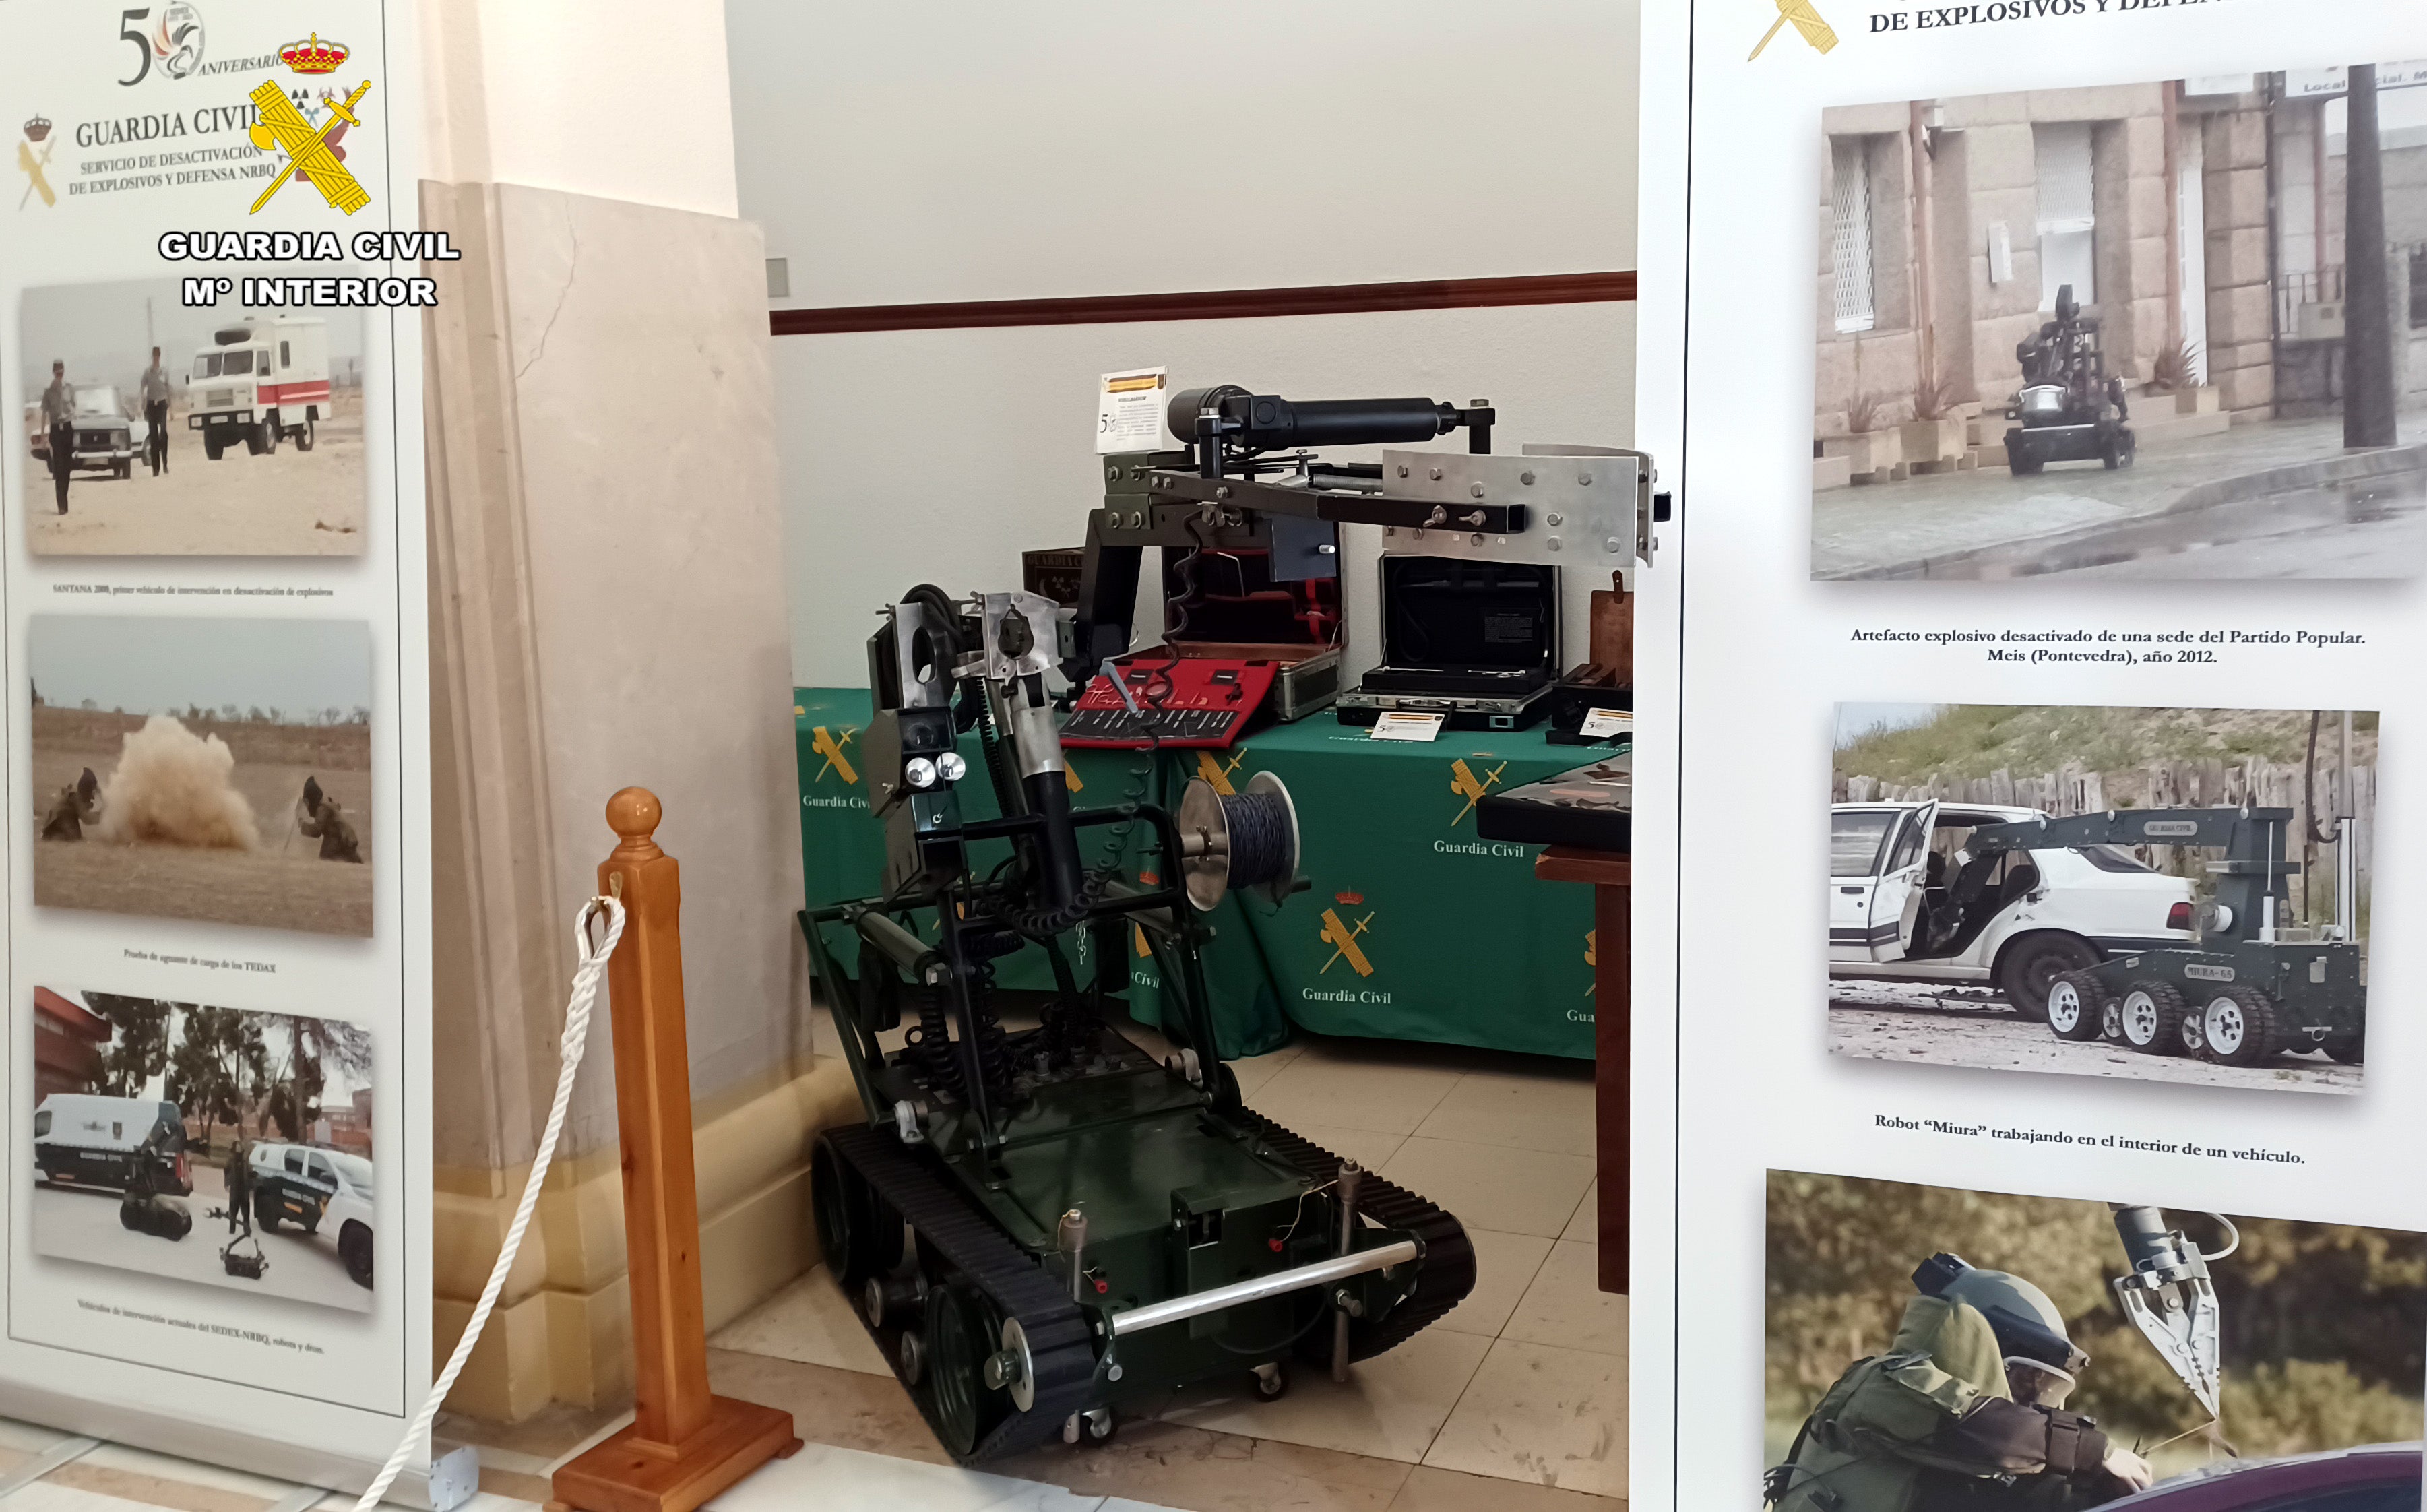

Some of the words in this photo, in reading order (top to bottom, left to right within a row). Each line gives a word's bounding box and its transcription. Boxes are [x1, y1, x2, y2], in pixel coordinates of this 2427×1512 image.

[1869, 12, 1908, 32] DE
[1916, 0, 2087, 29] EXPLOSIVOS
[75, 112, 187, 148] GUARDIA
[80, 157, 135, 175] SERVICIO
[139, 155, 156, 168] DE
[160, 142, 263, 166] DESACTIVACIÓN
[69, 181, 87, 195] DE
[90, 174, 163, 193] EXPLOSIVOS
[165, 173, 175, 187] Y
[176, 167, 236, 185] DEFENSA
[239, 163, 276, 180] NRBQ
[1852, 629, 1920, 641] Artefacto
[1924, 629, 1996, 645] explosivo
[2000, 629, 2093, 642] desactivado
[2098, 630, 2117, 643] de
[2122, 633, 2152, 643] una
[2157, 630, 2194, 643] sede
[2199, 630, 2224, 643] del
[2229, 631, 2290, 644] Partido
[2296, 631, 2366, 648] Popular.
[1987, 649, 2026, 662] Meis
[2031, 649, 2137, 665] (Pontevedra),
[2143, 650, 2172, 663] año
[2177, 650, 2217, 664] 2012.
[802, 795, 847, 807] Guardia
[850, 796, 871, 809] Civi
[1433, 840, 1488, 855] Guardia
[1492, 844, 1523, 858] Civil
[245, 962, 276, 973] TEDAX
[1135, 972, 1159, 989] Civil
[1302, 988, 1356, 1002] Guardia
[1360, 991, 1391, 1004] Civil
[1874, 1114, 1920, 1130] Robot
[1924, 1119, 1986, 1137] “Miura”
[1991, 1128, 2073, 1144] trabajando
[2077, 1136, 2096, 1145] en
[2101, 1135, 2114, 1147] el
[2119, 1136, 2178, 1153] interior
[2182, 1143, 2201, 1156] de
[2206, 1149, 2227, 1158] un
[2232, 1147, 2305, 1164] vehículo.
